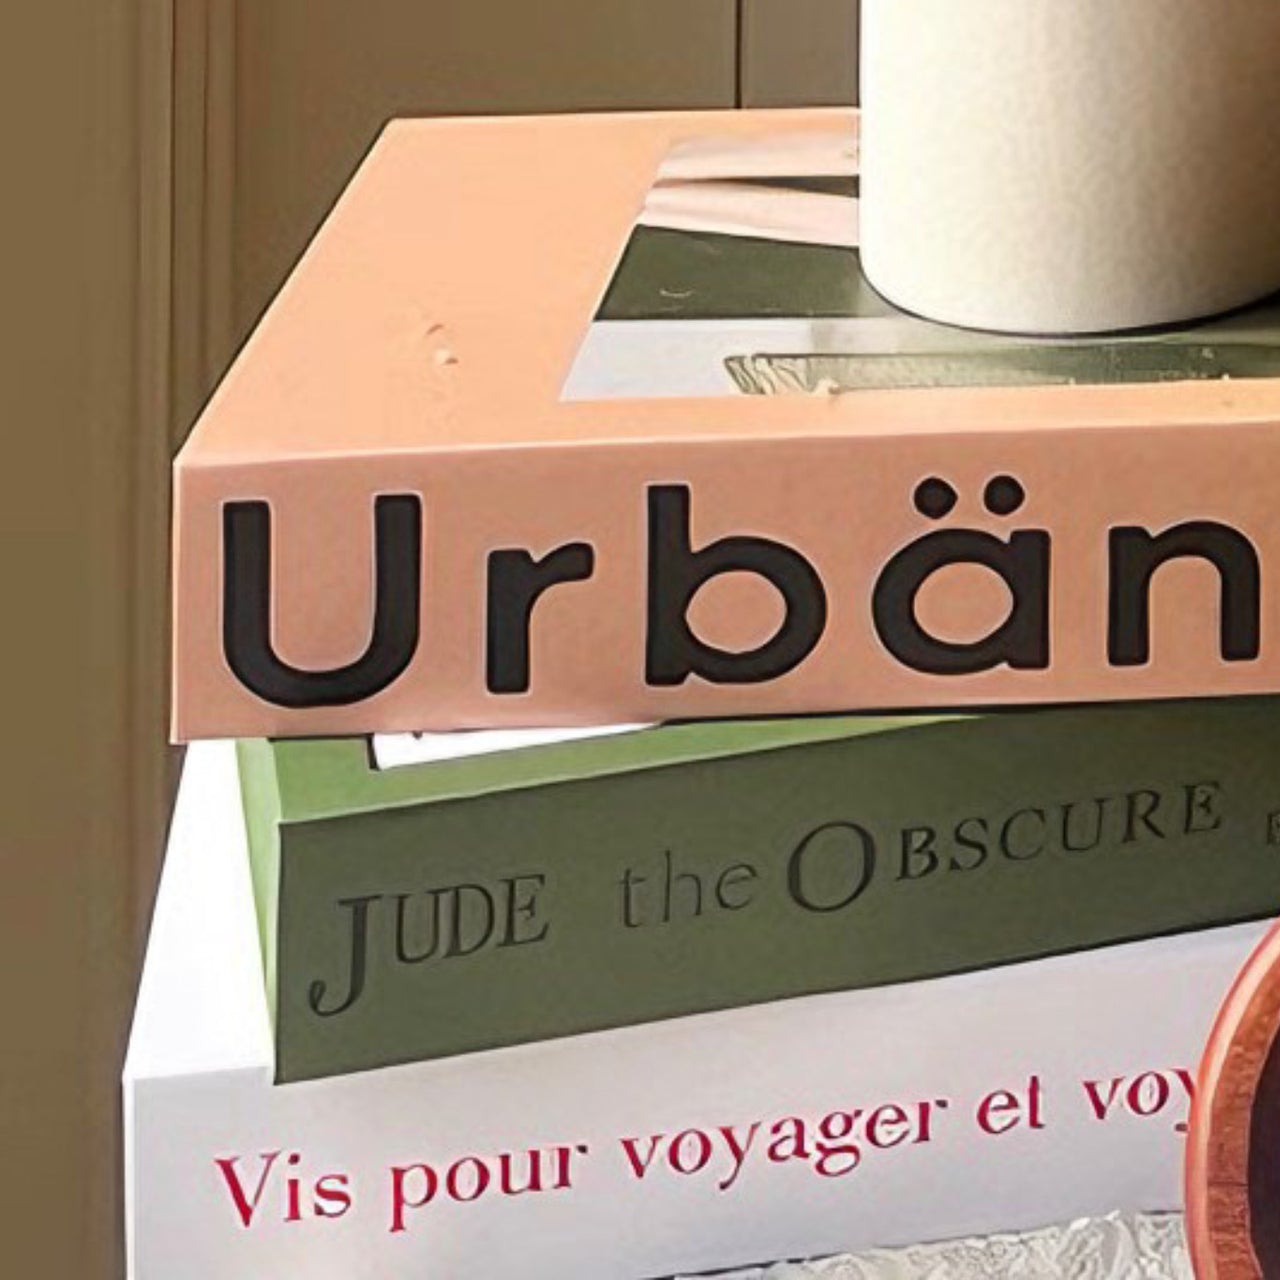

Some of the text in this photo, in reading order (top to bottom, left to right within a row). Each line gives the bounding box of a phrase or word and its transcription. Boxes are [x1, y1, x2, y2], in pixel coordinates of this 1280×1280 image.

[308, 780, 1223, 1017] JUDE the OBSCURE
[214, 1151, 352, 1228] Vis
[389, 1145, 588, 1232] pour
[620, 1098, 949, 1198] voyager
[976, 1076, 1046, 1134] et
